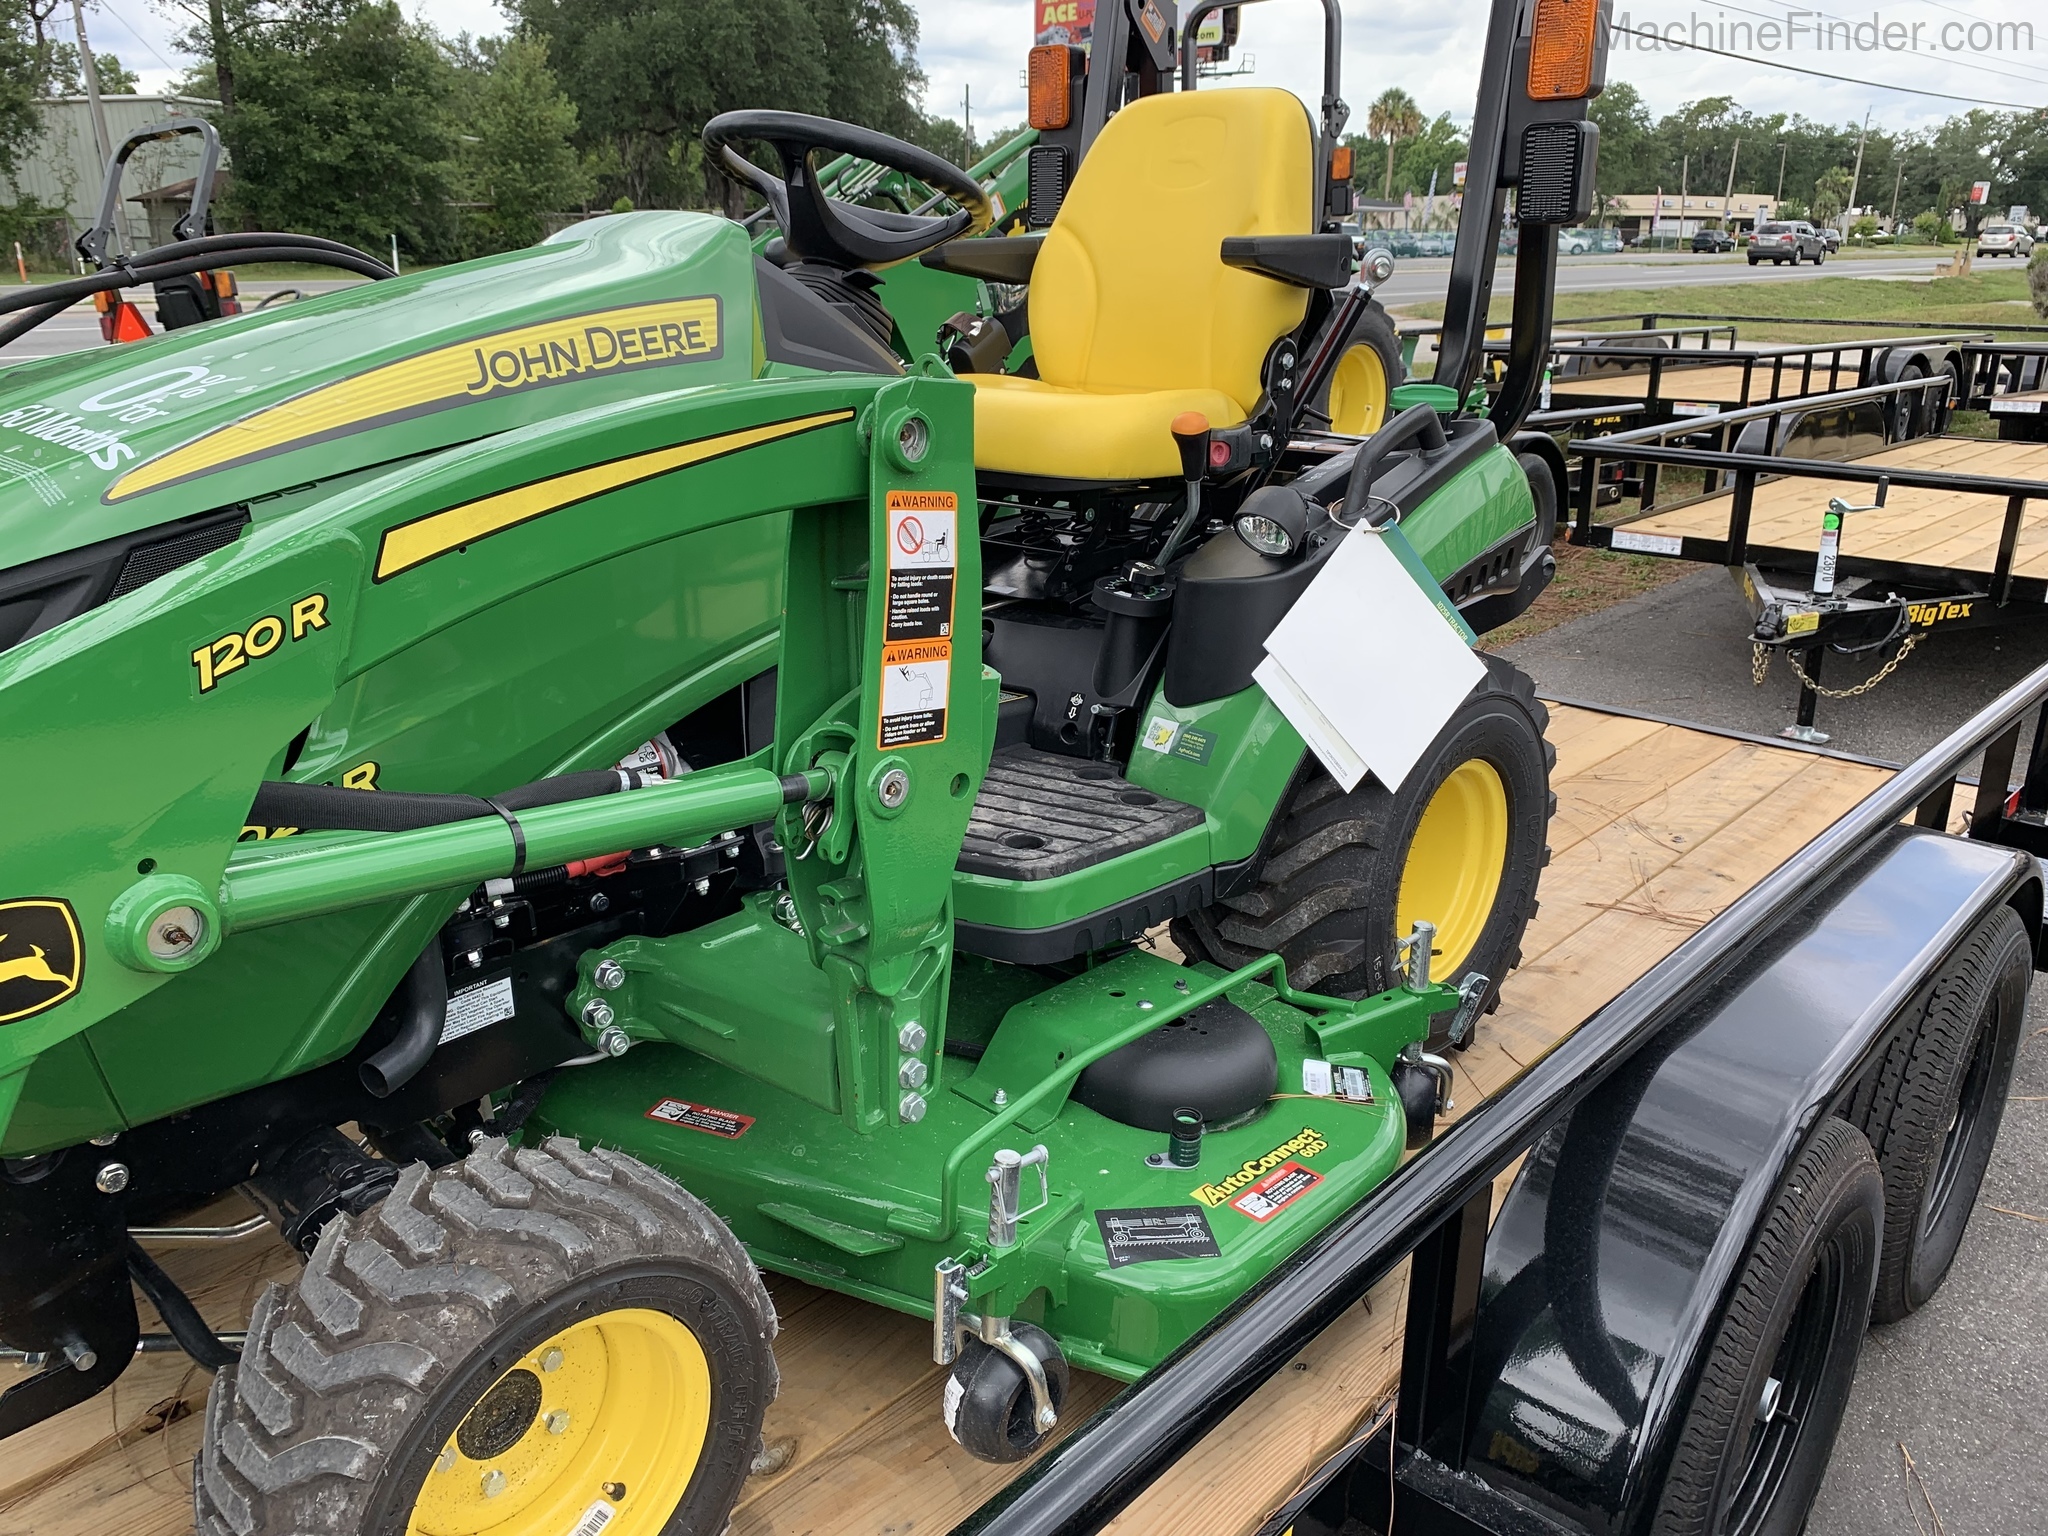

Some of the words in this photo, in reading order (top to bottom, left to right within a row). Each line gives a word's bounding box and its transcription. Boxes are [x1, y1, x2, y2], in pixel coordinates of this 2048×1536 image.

[1043, 3, 1078, 25] ACE
[466, 338, 583, 392] JOHN
[584, 320, 709, 366] DEERE
[108, 398, 169, 424] for
[18, 412, 136, 470] Months
[902, 496, 953, 508] WARNING
[1822, 555, 1836, 582] 23670
[1908, 602, 1974, 627] BigTex
[1449, 616, 1469, 641] TRACTOR
[192, 614, 286, 694] 120
[291, 592, 332, 642] R
[898, 645, 947, 661] WARNING
[454, 979, 488, 997] IMPORTANT
[692, 1111, 717, 1120] ROTATING
[711, 1109, 738, 1120] DANGER
[1298, 1139, 1328, 1158] 60D
[1202, 1127, 1323, 1206] AutoConnect
